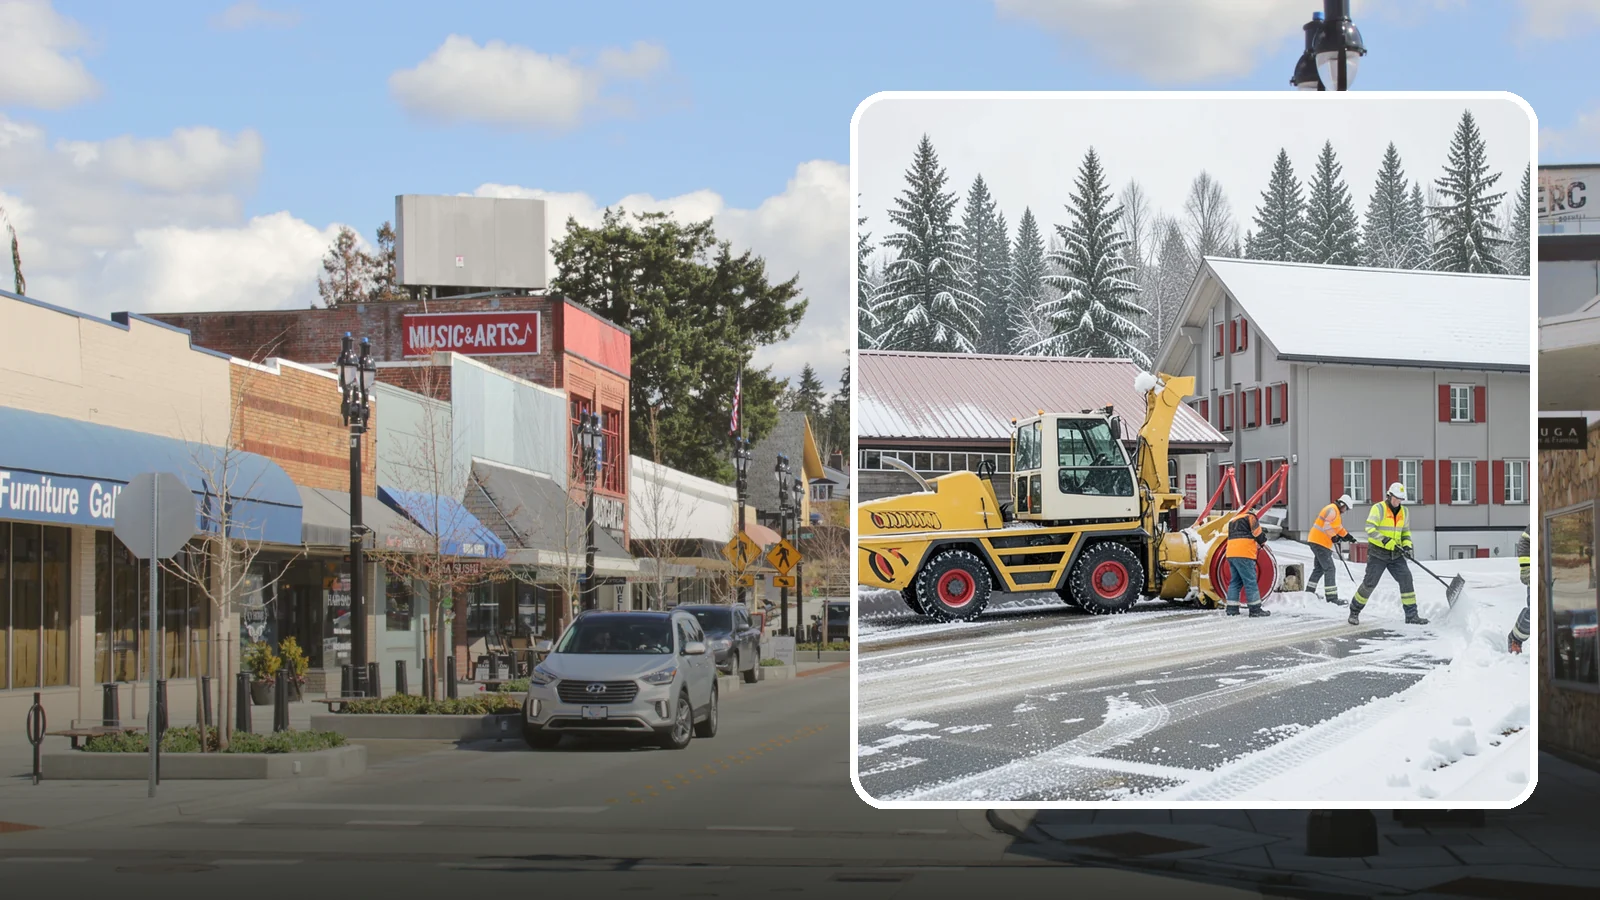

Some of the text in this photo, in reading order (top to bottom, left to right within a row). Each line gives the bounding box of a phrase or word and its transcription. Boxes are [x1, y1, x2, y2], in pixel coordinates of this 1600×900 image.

[409, 323, 519, 348] MUSIC&ARTS
[0, 472, 121, 519] Furniture Gal
[453, 563, 479, 574] SUSHI
